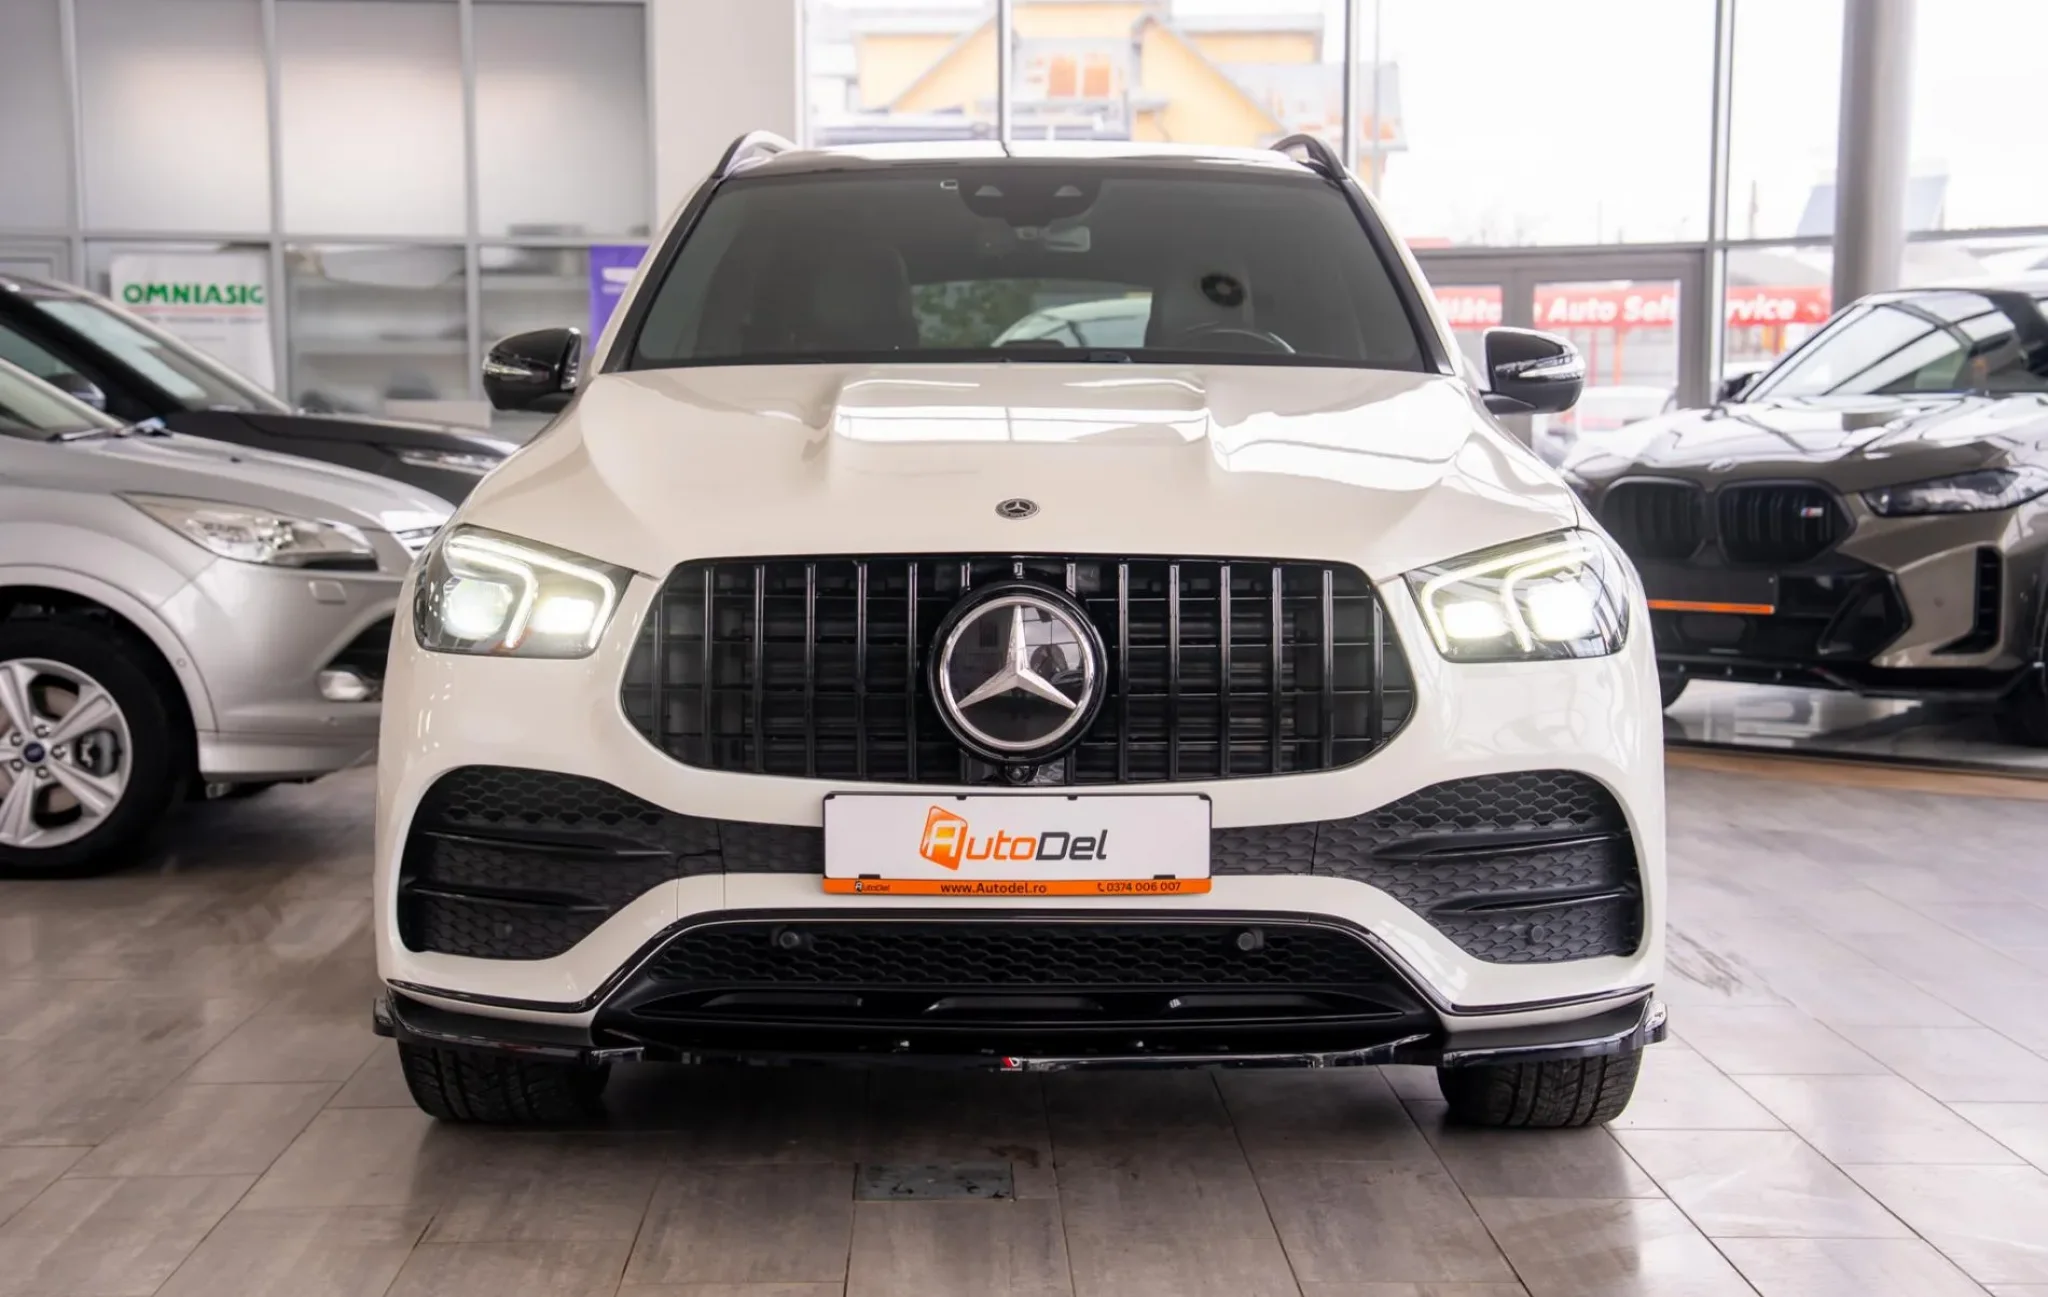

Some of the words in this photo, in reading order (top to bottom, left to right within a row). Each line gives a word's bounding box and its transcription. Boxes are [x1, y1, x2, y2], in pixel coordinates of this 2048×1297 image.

[1548, 296, 1617, 323] Auto
[1725, 293, 1797, 321] rvice
[924, 819, 1109, 862] AutoDel
[940, 882, 1048, 894] www.Autodel.ro
[1106, 882, 1133, 893] 0374
[1135, 882, 1158, 892] 006
[1160, 881, 1182, 892] 007
